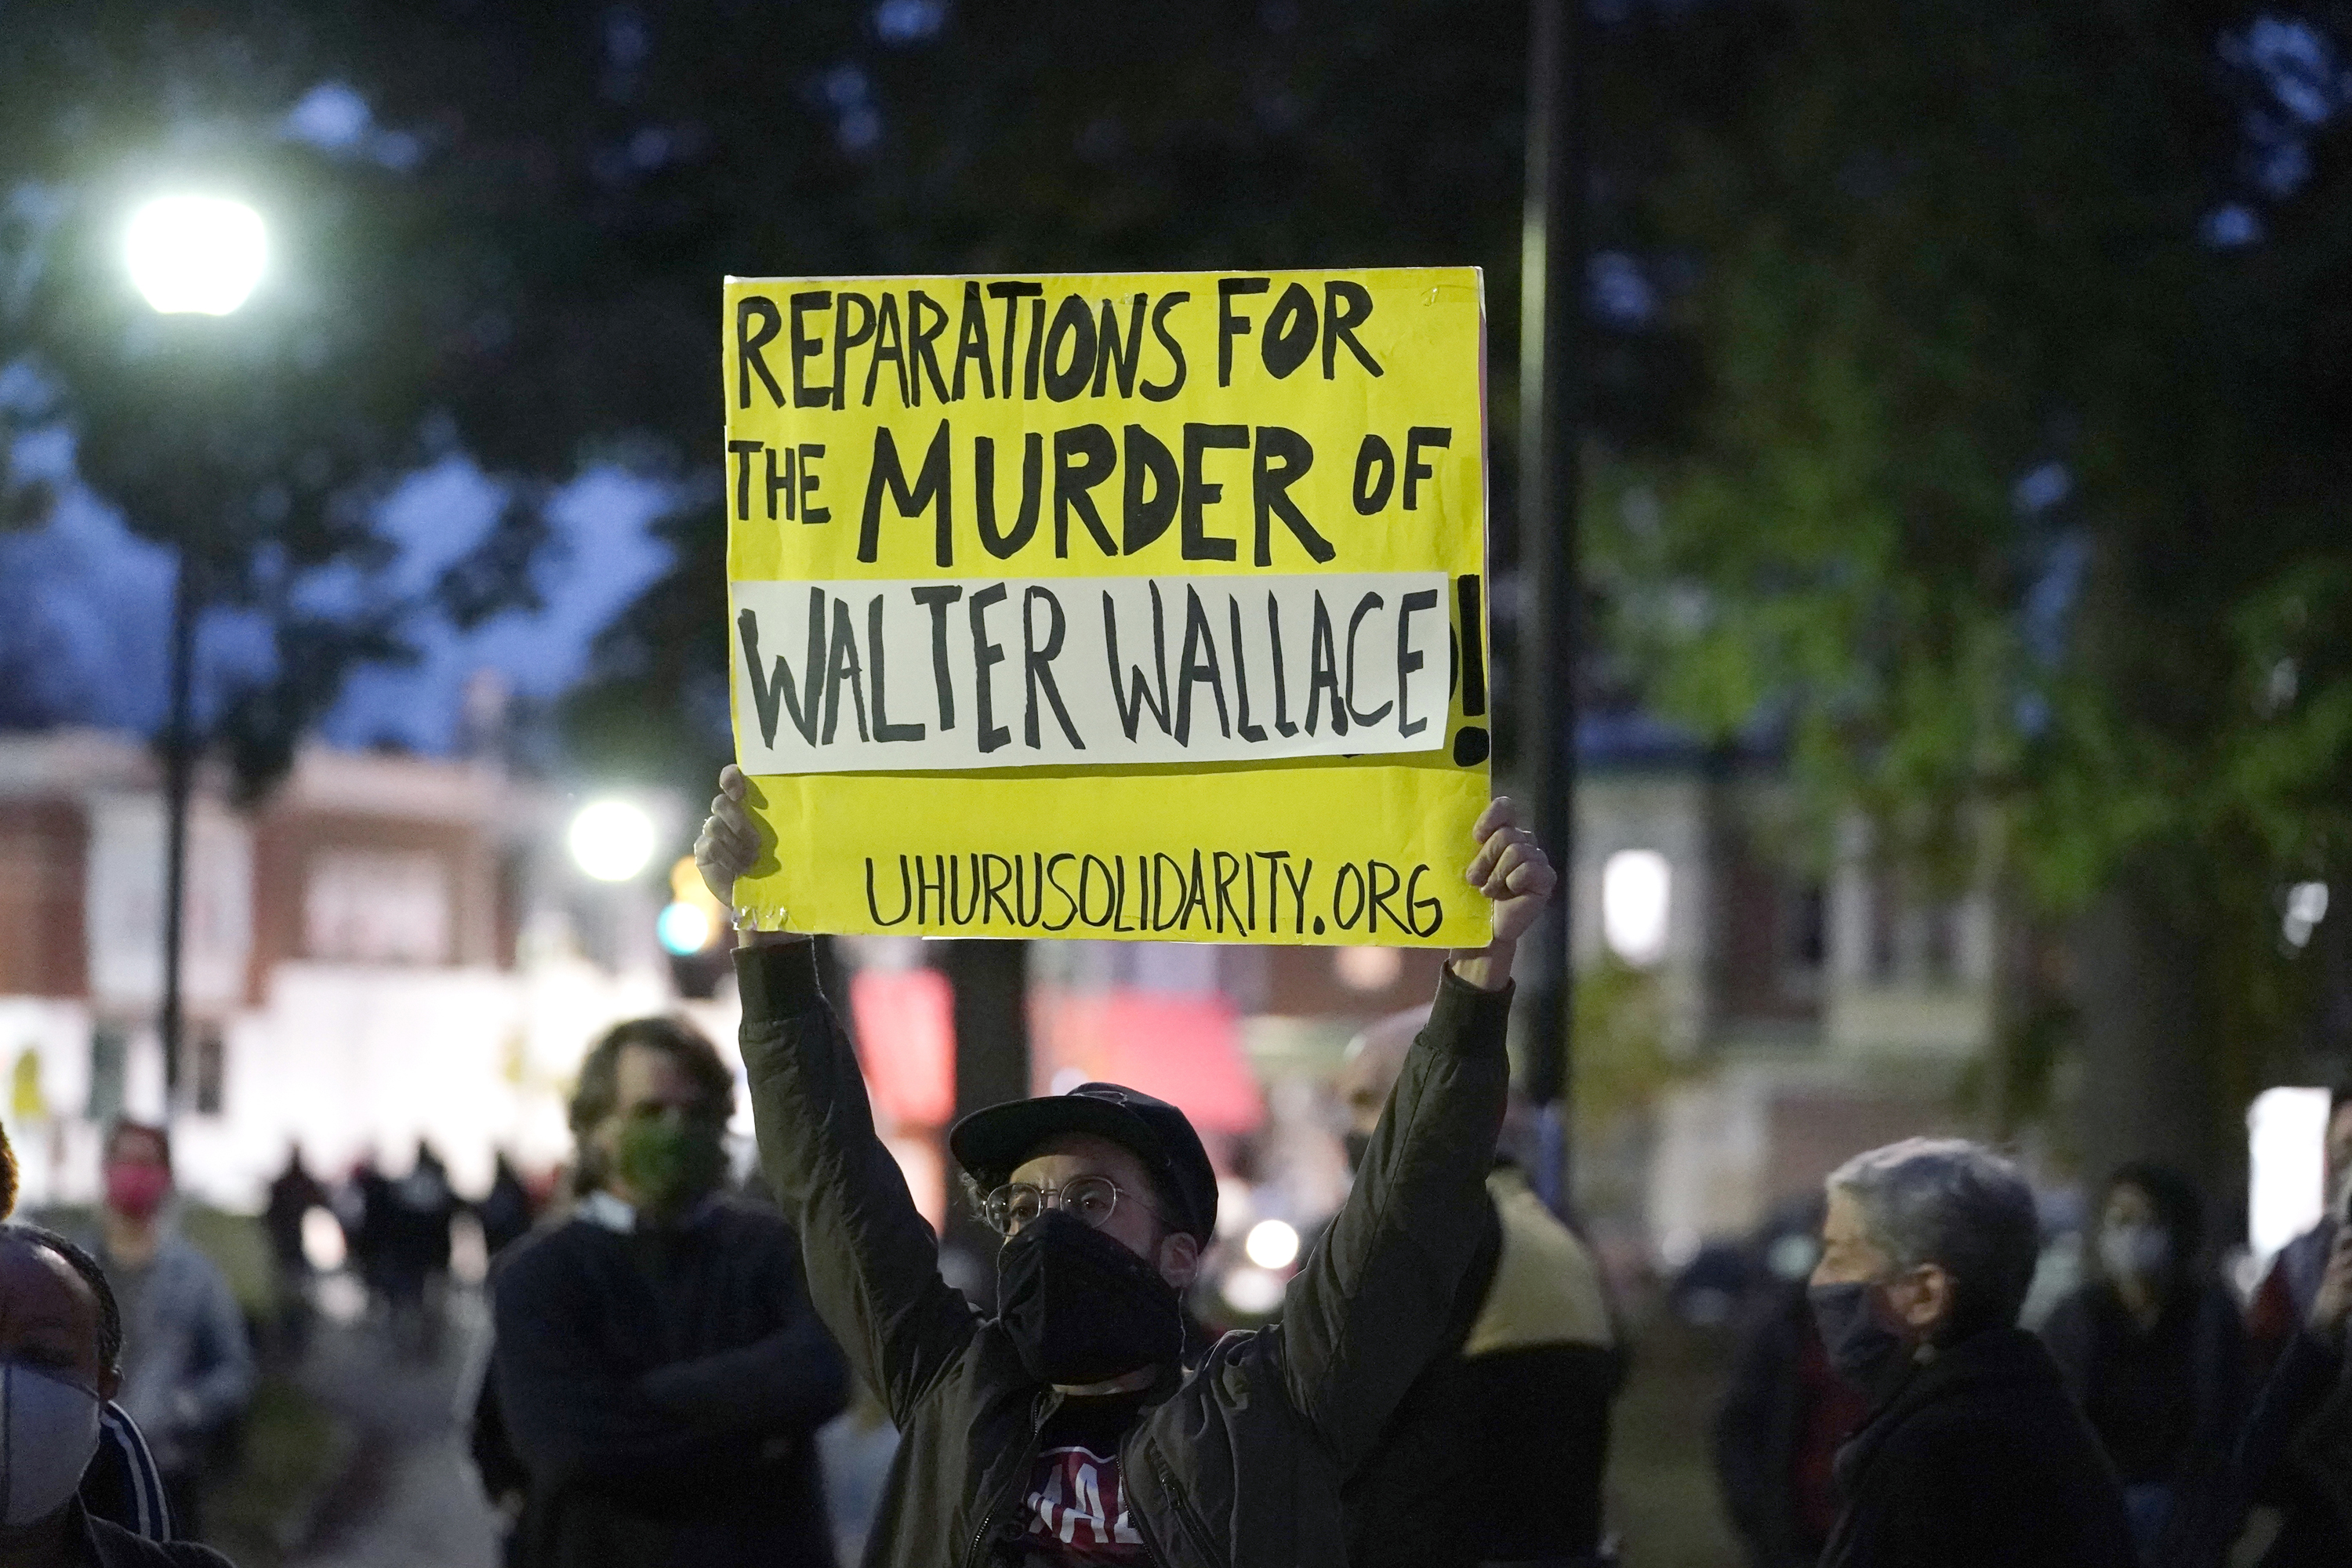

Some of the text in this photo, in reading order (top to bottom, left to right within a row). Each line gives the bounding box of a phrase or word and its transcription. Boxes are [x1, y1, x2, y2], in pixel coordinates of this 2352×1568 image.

[736, 277, 1384, 411] REPARATIONS FOR
[728, 418, 1451, 568] THE MURDER OF
[737, 582, 1087, 753] WALTER
[865, 848, 1443, 938] UHURUSOLIDARITY.ORG
